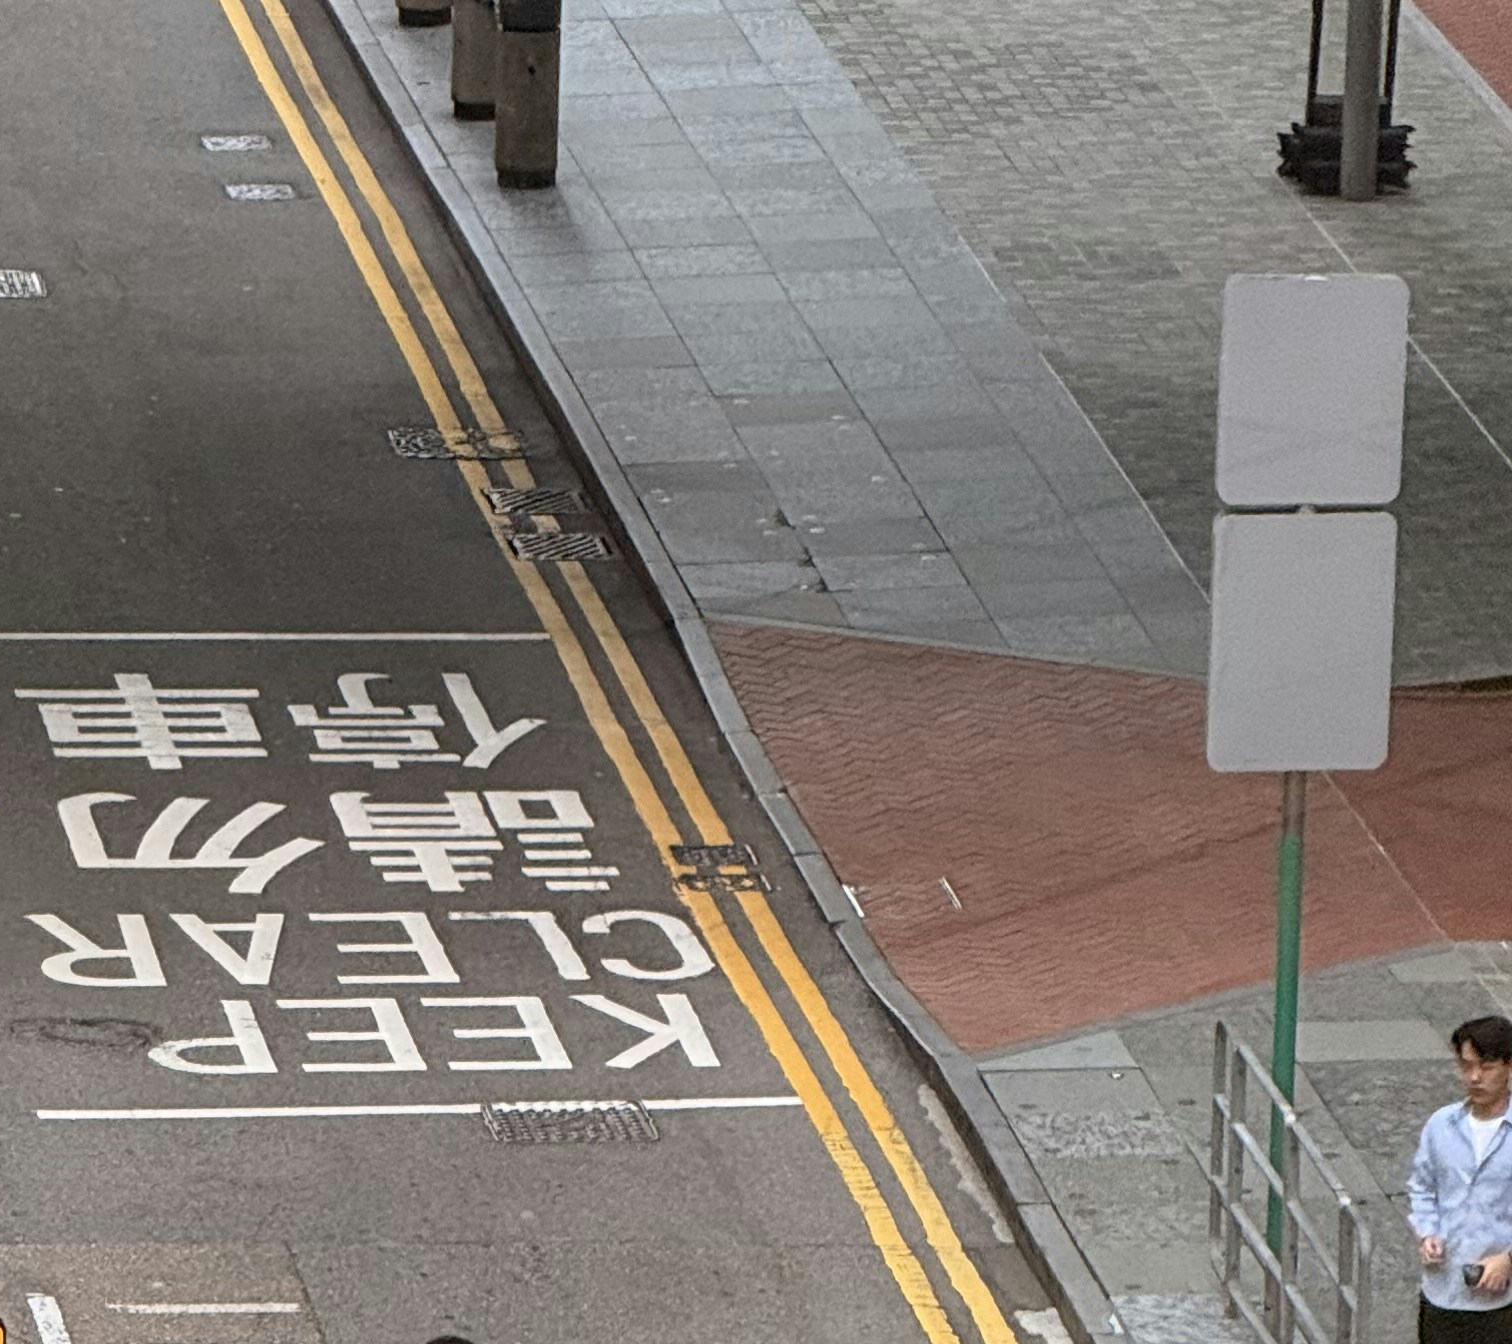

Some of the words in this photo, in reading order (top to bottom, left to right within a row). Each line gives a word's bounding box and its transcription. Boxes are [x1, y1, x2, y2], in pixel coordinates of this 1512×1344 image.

[15, 673, 545, 770] 停車
[57, 789, 620, 894] 請勿
[24, 909, 716, 988] CLEAR
[147, 993, 722, 1075] KEEP
